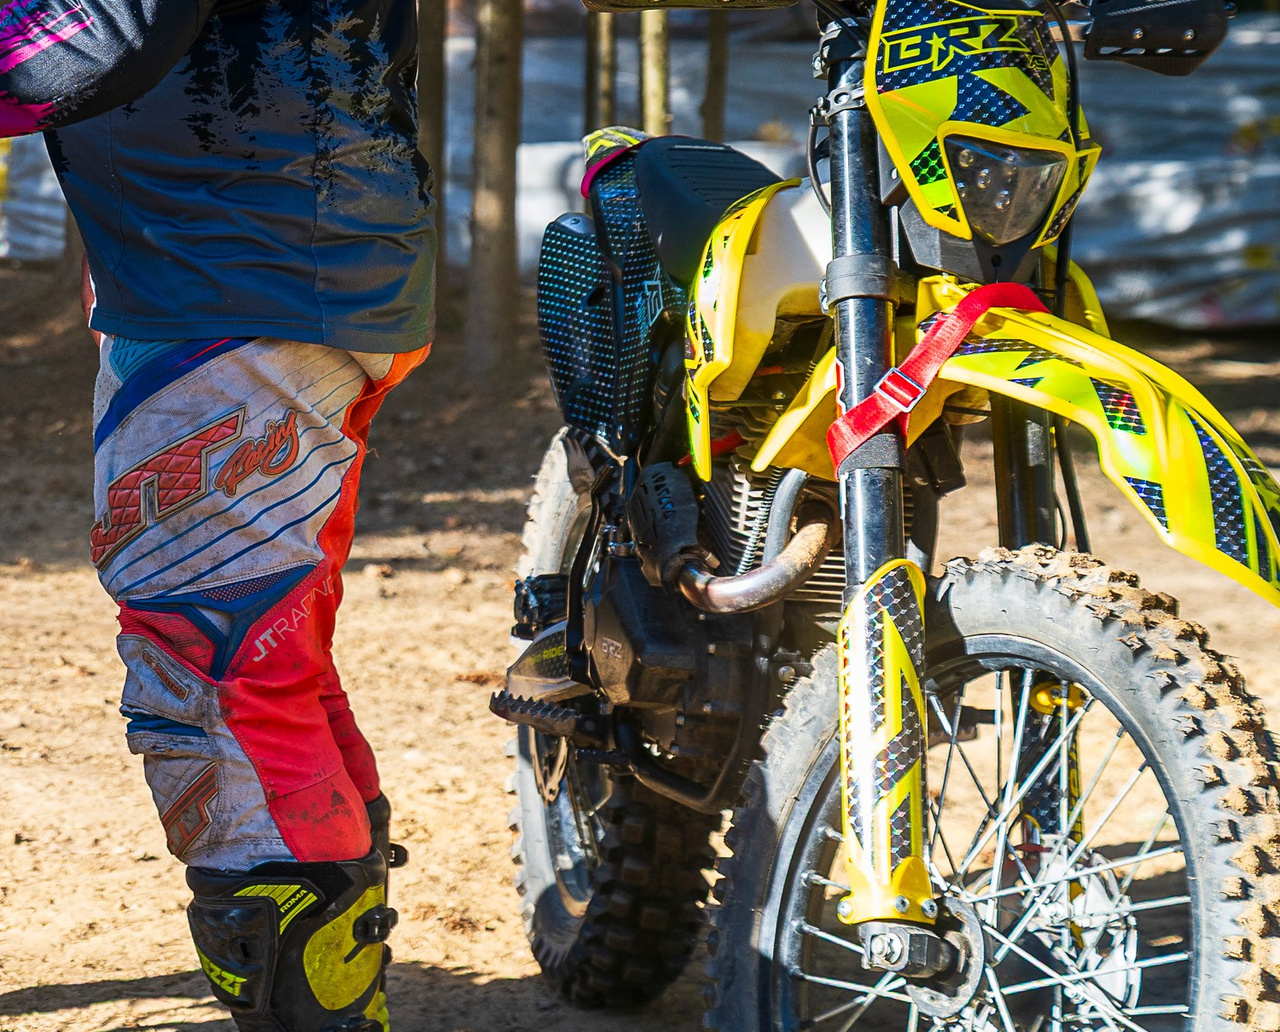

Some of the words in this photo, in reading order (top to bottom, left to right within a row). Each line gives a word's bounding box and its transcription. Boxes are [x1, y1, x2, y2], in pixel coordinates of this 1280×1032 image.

[881, 16, 1031, 72] BRZ
[90, 404, 247, 572] JT
[213, 408, 300, 497] Racing
[279, 889, 308, 913] ROMA
